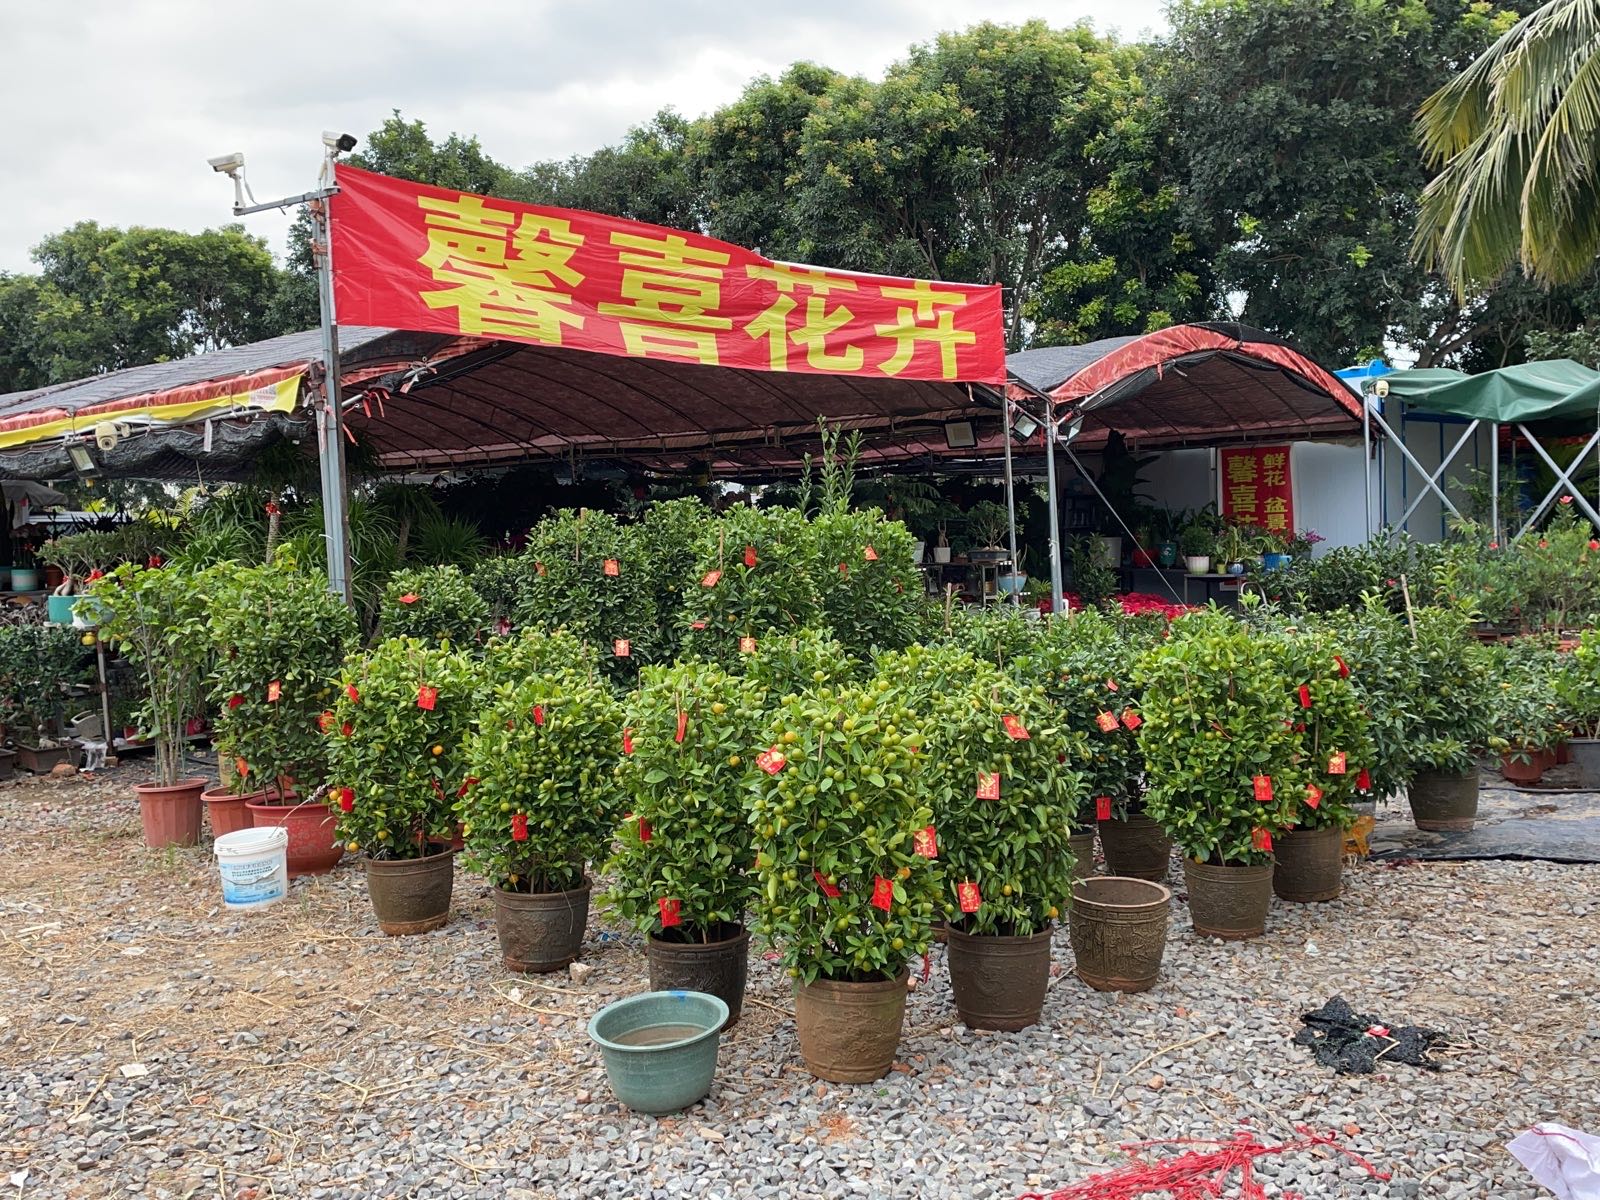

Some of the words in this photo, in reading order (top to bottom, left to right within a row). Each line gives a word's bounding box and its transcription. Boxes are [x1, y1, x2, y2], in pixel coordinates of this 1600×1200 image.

[417, 195, 977, 380] 馨喜花卉
[1263, 452, 1286, 487] 鲜花
